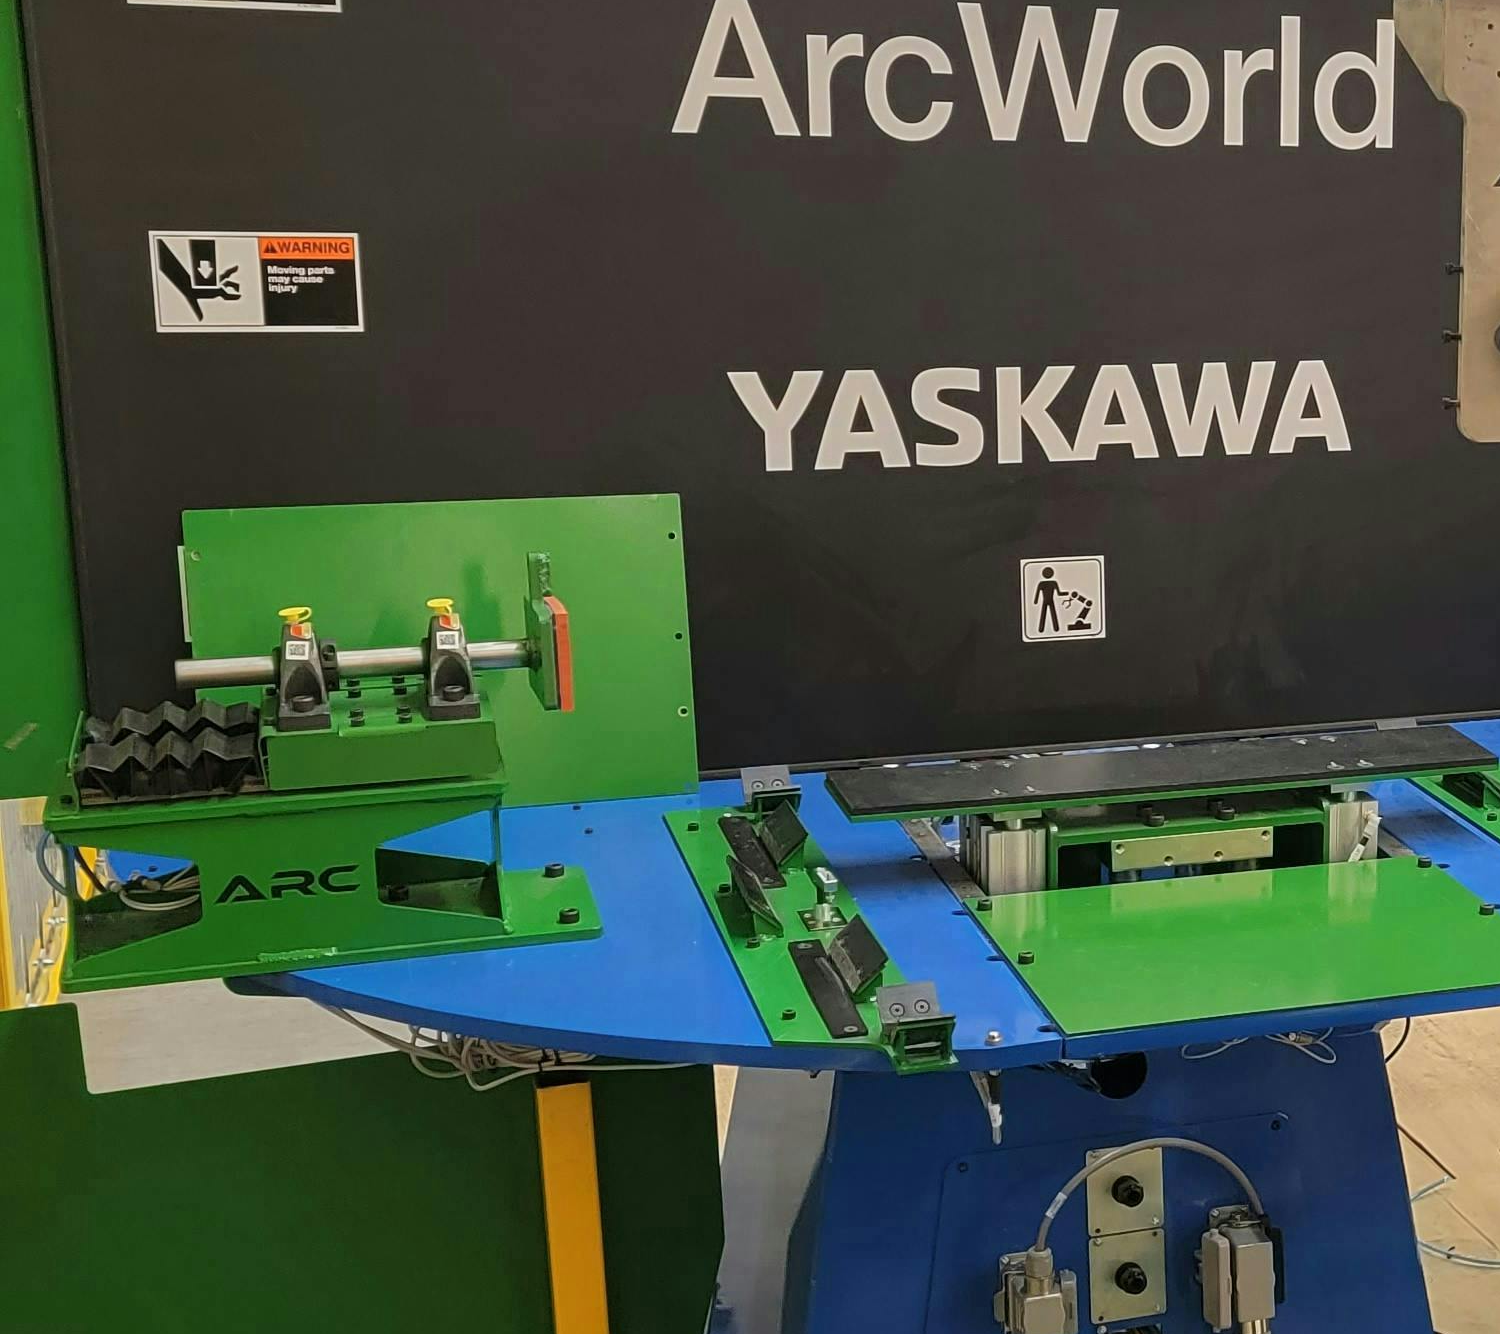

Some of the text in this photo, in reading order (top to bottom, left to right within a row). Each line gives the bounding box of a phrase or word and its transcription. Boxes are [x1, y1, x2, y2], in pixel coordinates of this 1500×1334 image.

[277, 241, 350, 254] WARNING
[267, 266, 335, 277] Moving parts
[268, 276, 323, 285] may cause
[268, 284, 298, 293] injury
[726, 359, 1352, 472] YASKAWA
[214, 864, 361, 905] ARC
